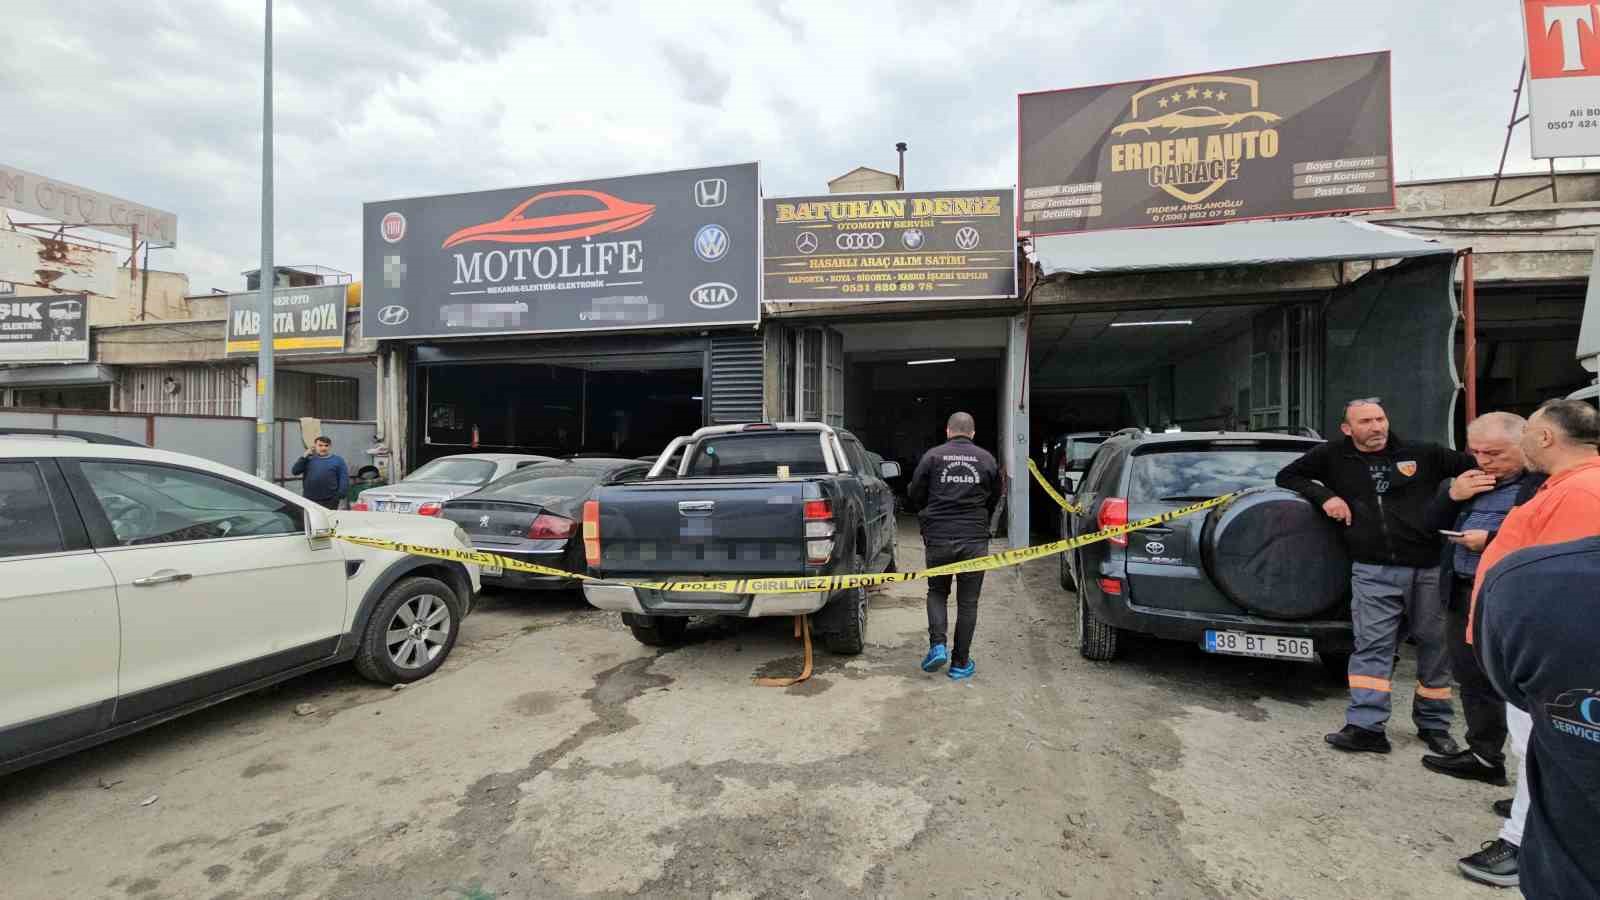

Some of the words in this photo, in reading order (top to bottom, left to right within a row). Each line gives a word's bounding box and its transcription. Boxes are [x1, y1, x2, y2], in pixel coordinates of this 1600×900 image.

[1543, 4, 1600, 72] T
[1547, 120, 1574, 130] 0507
[1578, 119, 1597, 128] 424
[1111, 137, 1199, 172] ERDEM
[1205, 128, 1279, 161] AUTO
[1149, 158, 1240, 188] GARAGE
[775, 198, 906, 224] BATUHAN
[1146, 205, 1178, 215] ERDEM
[809, 258, 857, 269] HASARLI
[860, 257, 890, 269] ARAÇ
[893, 257, 922, 266] ALIM
[697, 288, 730, 303] KIA
[301, 302, 337, 332] BOYA
[1216, 633, 1237, 649] 38
[1246, 635, 1267, 651] BT
[1276, 638, 1310, 656] 506
